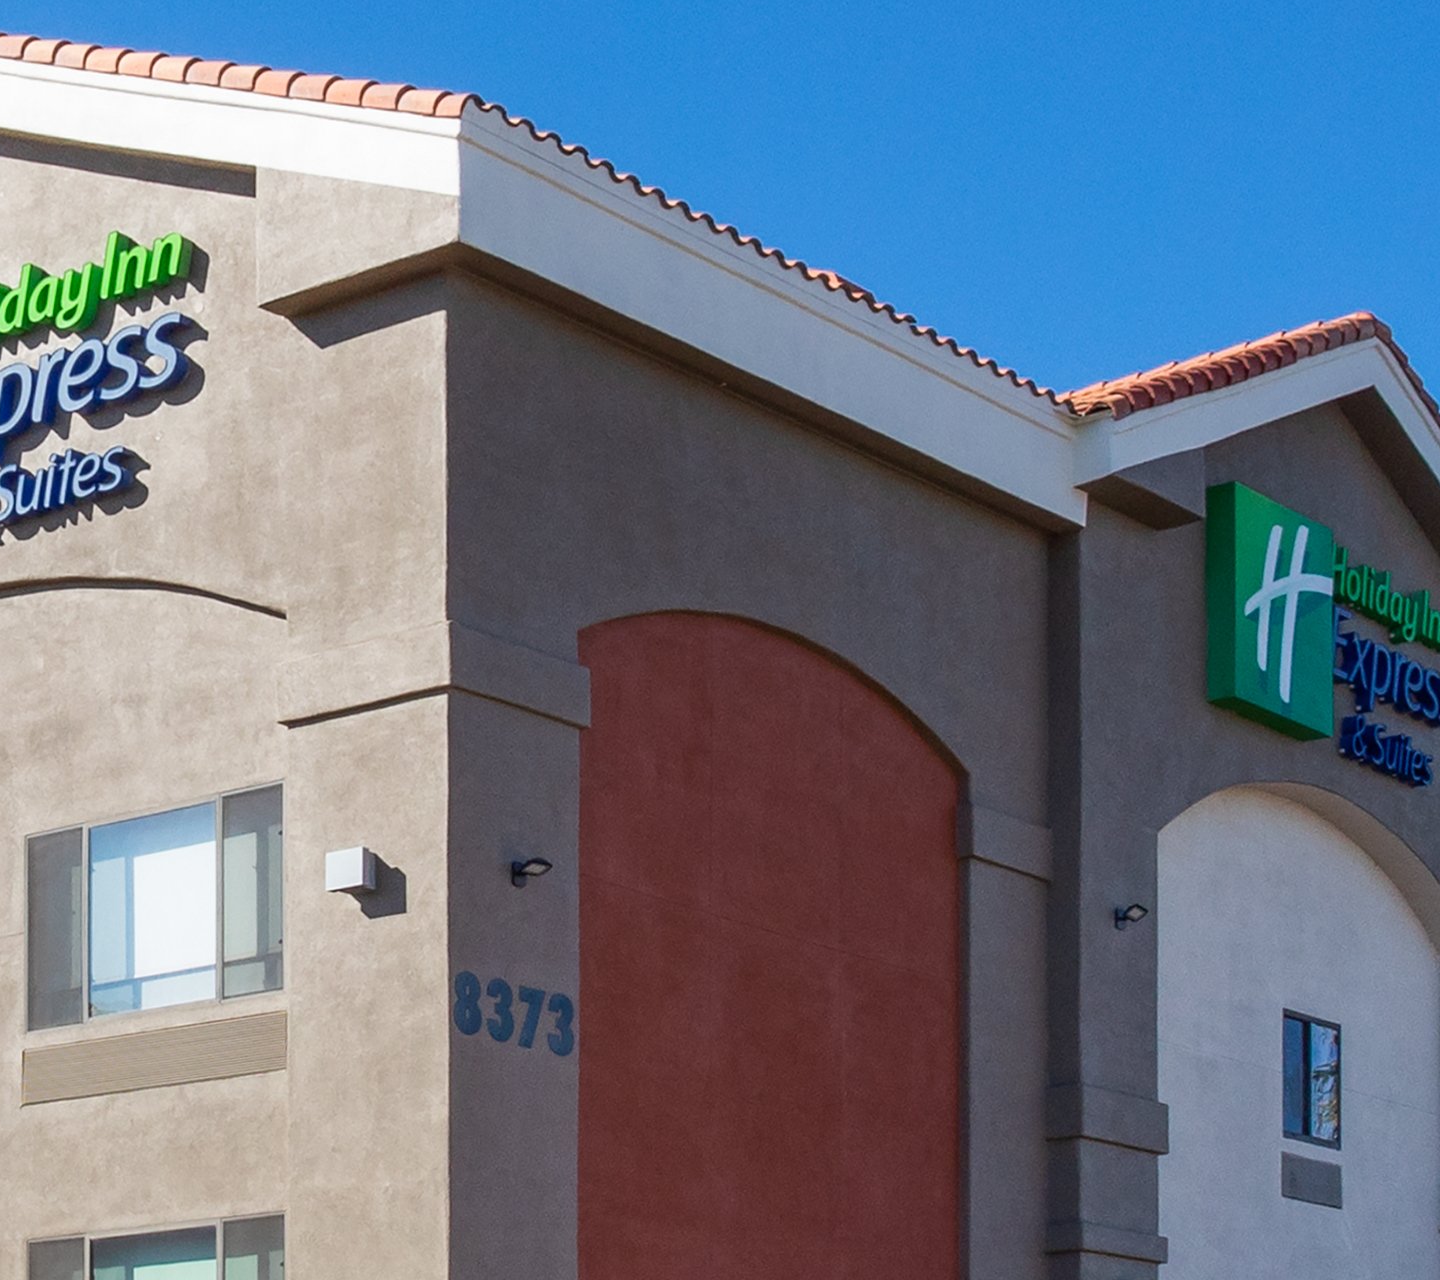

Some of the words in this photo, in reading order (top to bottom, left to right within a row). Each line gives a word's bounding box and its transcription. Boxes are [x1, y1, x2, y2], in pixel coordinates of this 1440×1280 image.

[100, 230, 186, 300] Inn
[1332, 543, 1421, 642] Holiday
[1373, 722, 1433, 786] Suites
[454, 971, 575, 1057] 8373
